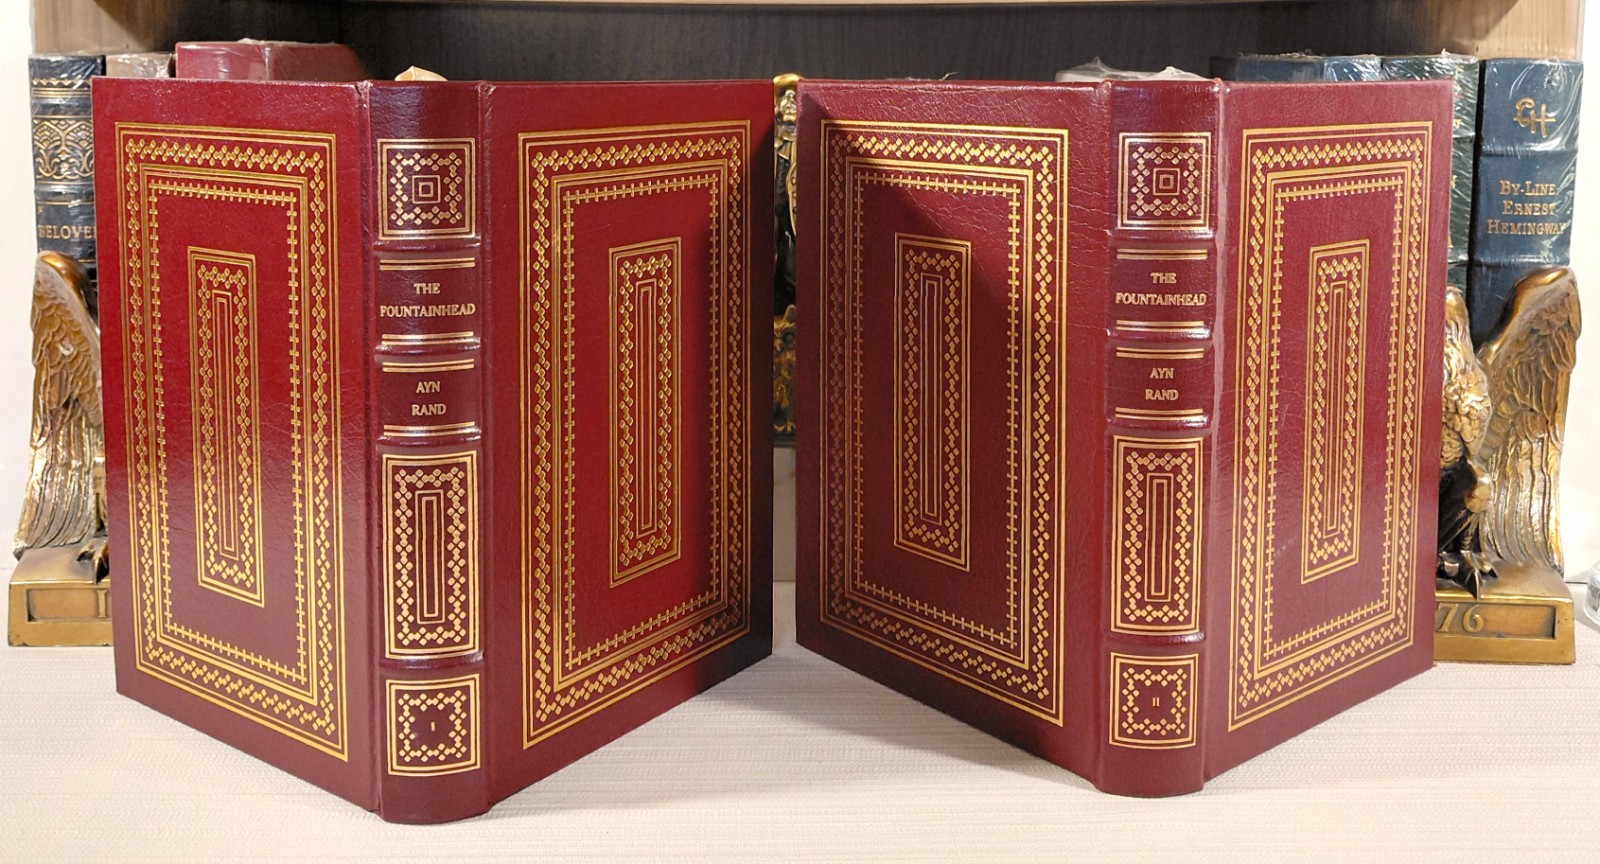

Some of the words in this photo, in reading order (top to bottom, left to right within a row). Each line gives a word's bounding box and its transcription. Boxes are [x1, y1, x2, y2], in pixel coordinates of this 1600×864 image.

[1150, 272, 1177, 284] THE
[414, 283, 441, 295] THE
[1115, 292, 1207, 306] FOUNTAINHEAD
[379, 303, 476, 317] FOUNTAINHEAD
[1150, 367, 1174, 379] AYN
[416, 381, 441, 393] AYN
[1145, 389, 1179, 400] RAND
[411, 403, 447, 416] RAND
